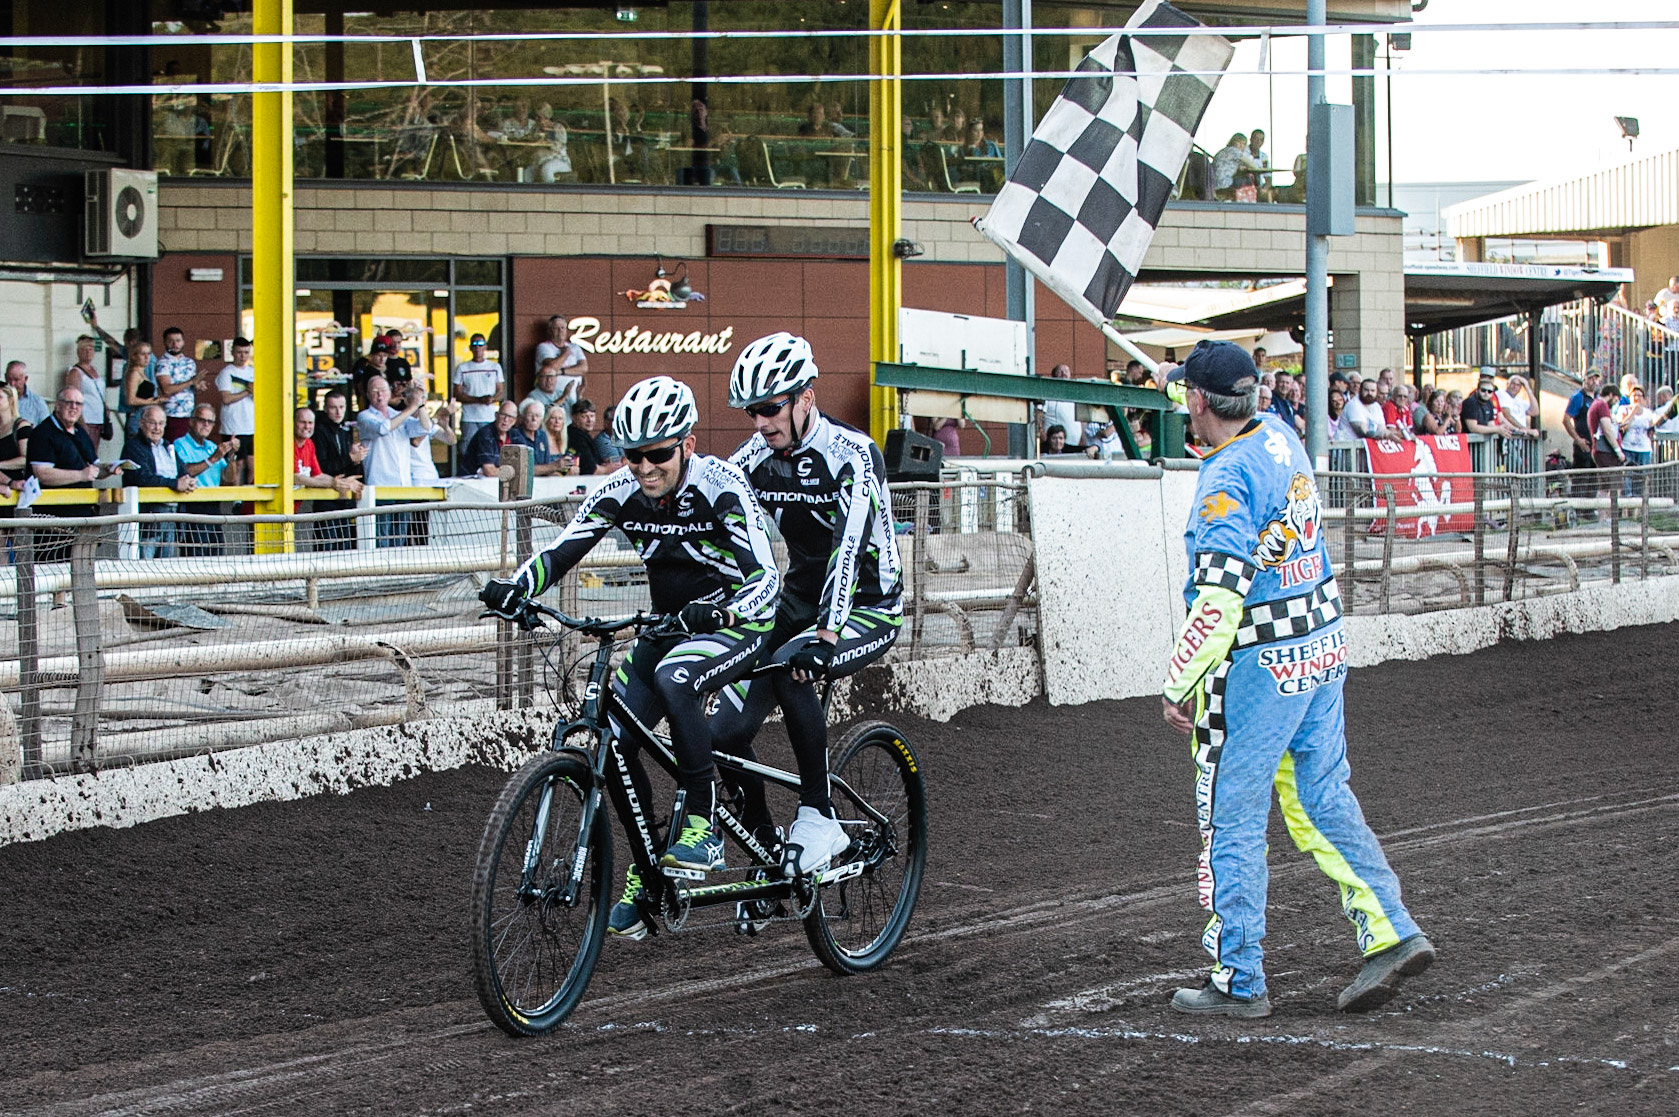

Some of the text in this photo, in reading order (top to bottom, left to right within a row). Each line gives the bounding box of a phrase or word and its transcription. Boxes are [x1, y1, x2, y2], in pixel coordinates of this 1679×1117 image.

[1466, 265, 1549, 278] SHEFFIELD WINDOW CENTRE
[568, 316, 733, 354] Restaurant
[1434, 434, 1461, 451] KINGS
[834, 535, 856, 626] CANNONDALE
[693, 635, 762, 692] CANNONDALE
[831, 628, 896, 668] ANNONDALE
[893, 739, 918, 773] MAXXIS
[716, 804, 777, 866] ANNONDALE
[833, 861, 865, 882] 29
